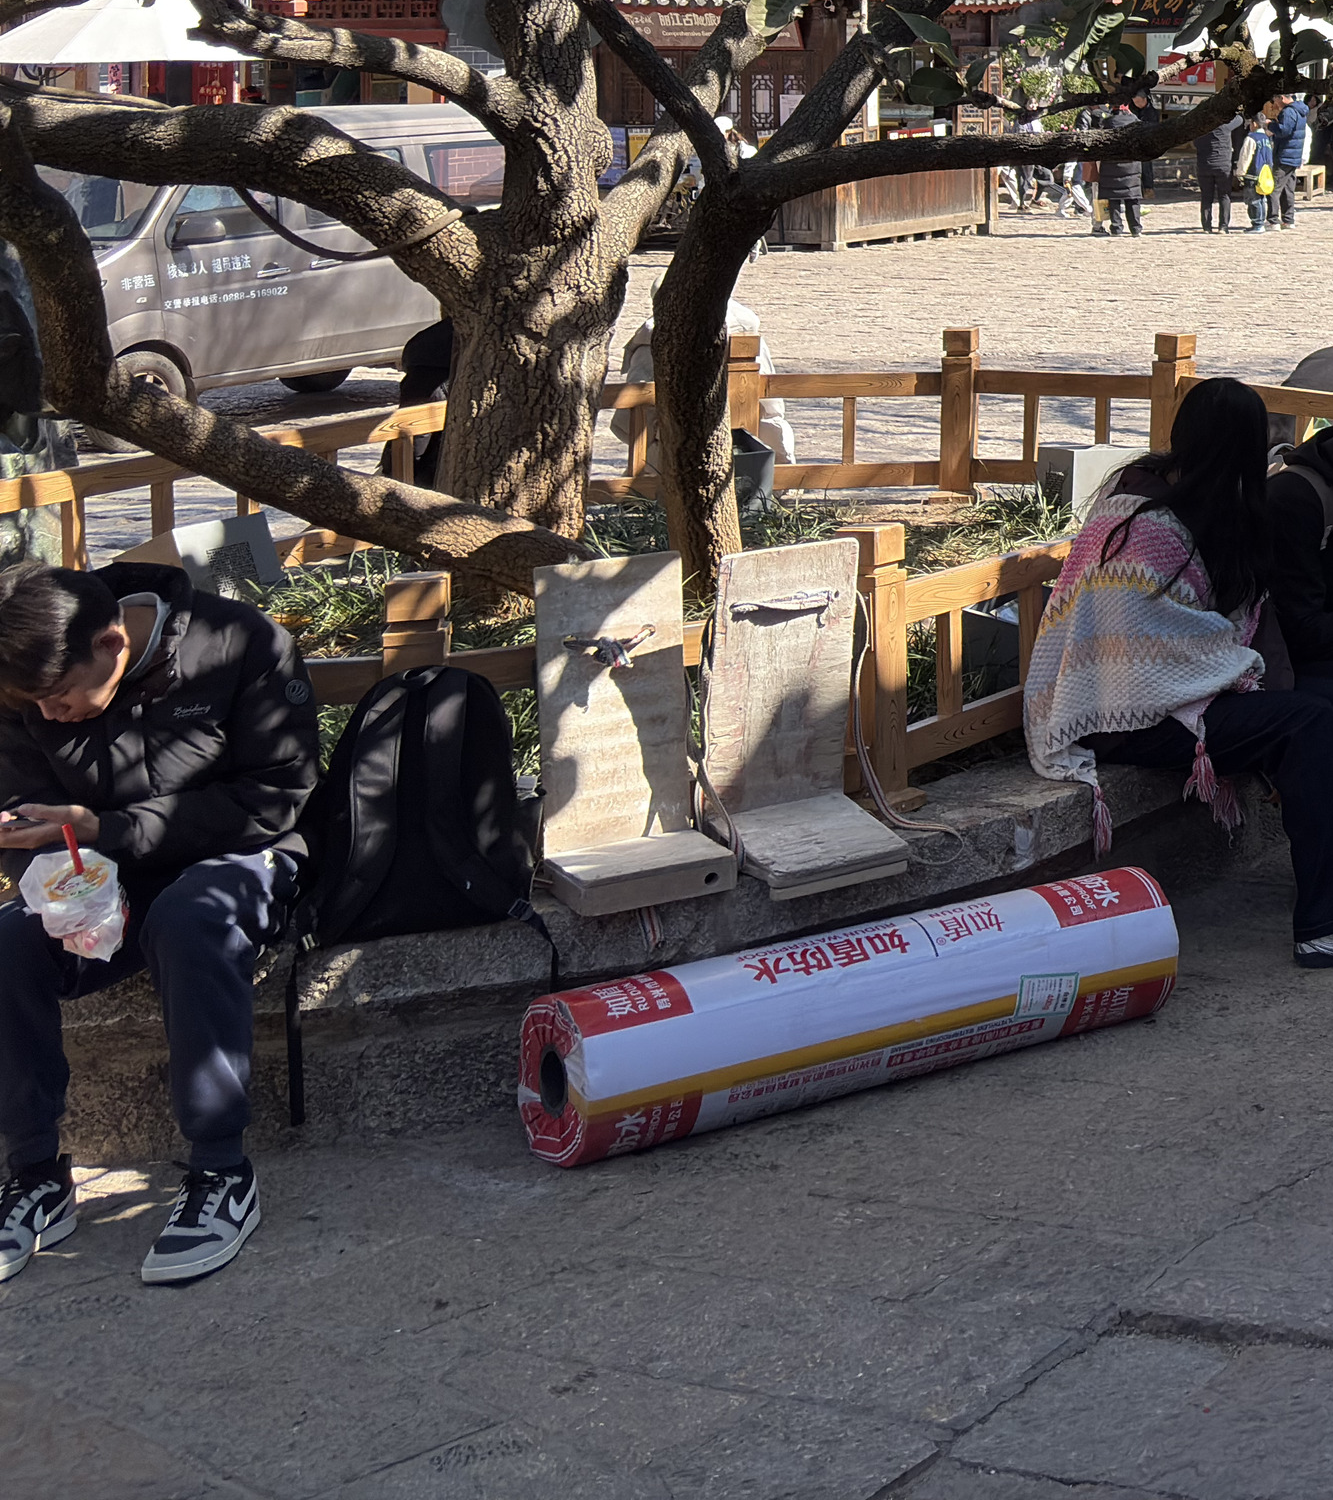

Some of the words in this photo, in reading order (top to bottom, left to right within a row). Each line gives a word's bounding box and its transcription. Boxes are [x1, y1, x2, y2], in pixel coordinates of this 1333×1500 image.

[662, 30, 700, 38] Comprehensive
[212, 254, 251, 274] 超员违法
[121, 274, 155, 291] 非营运
[743, 928, 911, 984] 如盾防水
